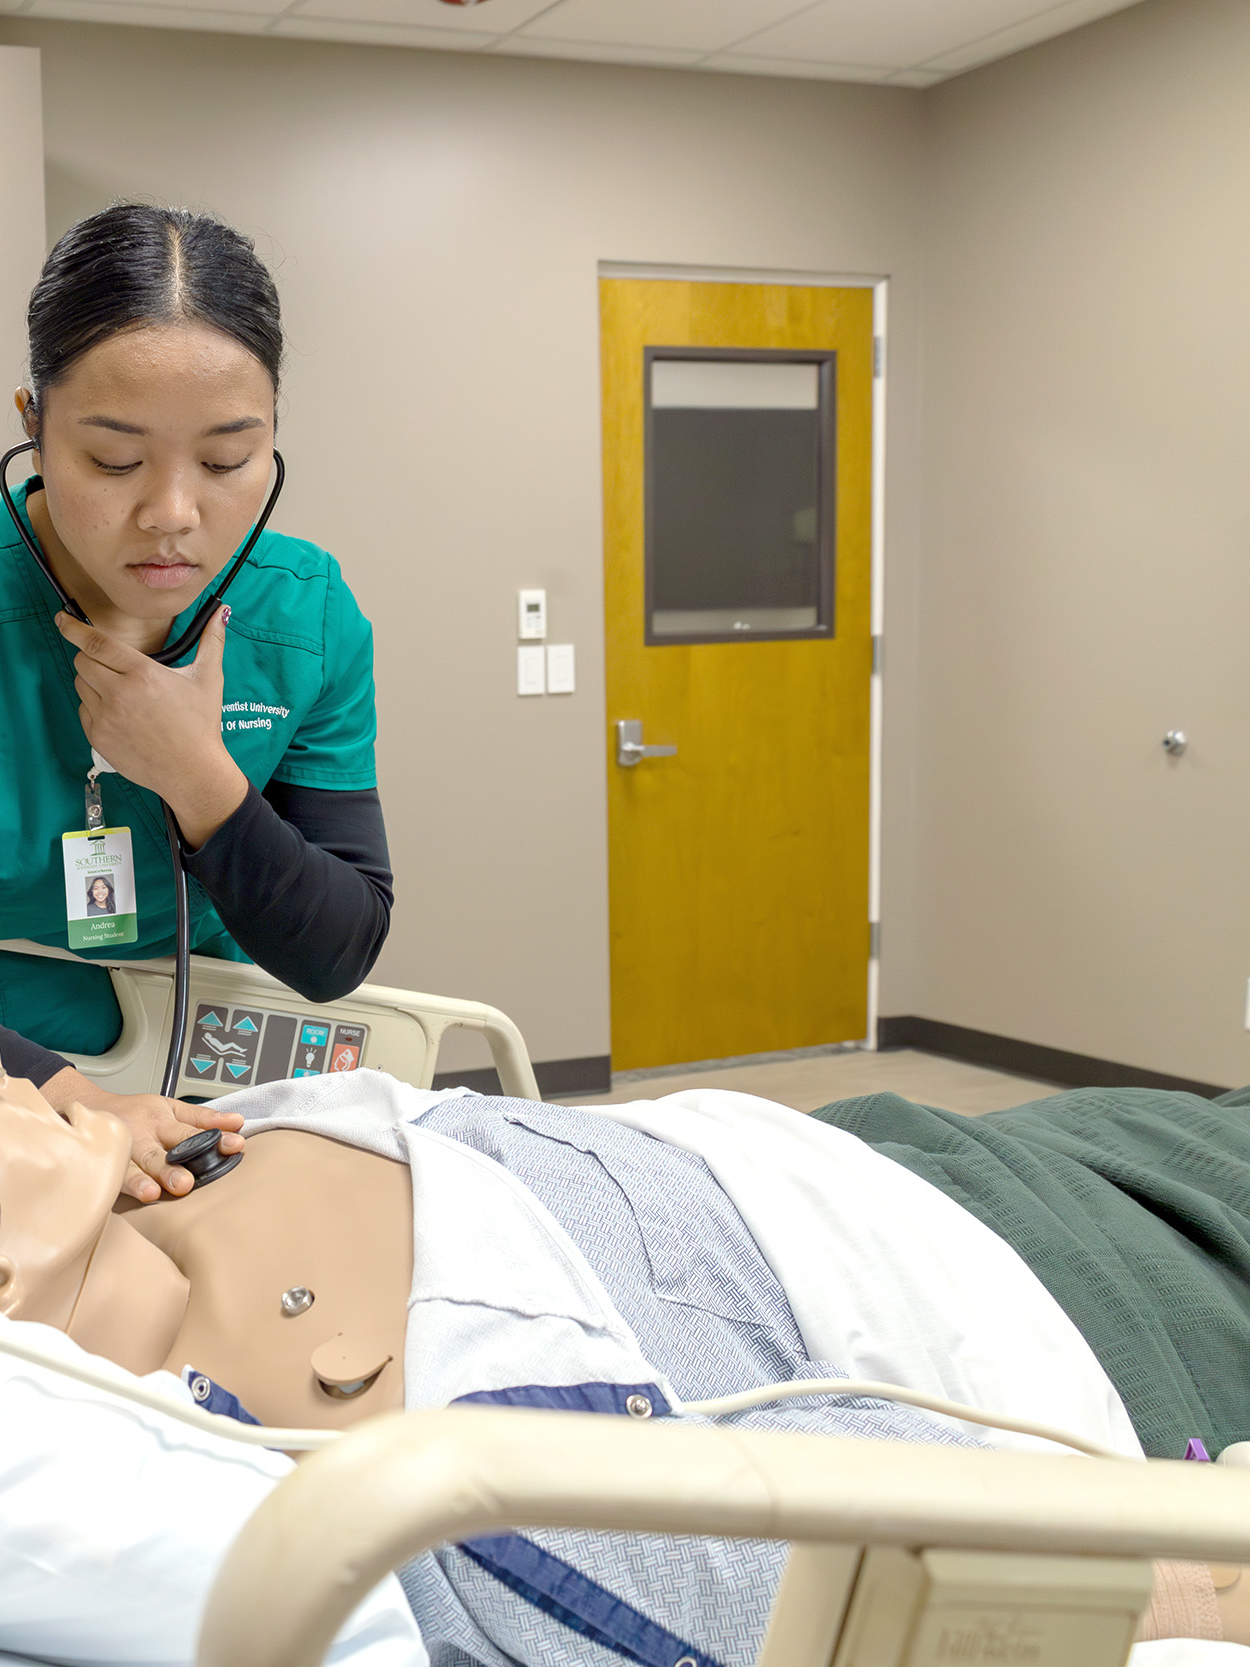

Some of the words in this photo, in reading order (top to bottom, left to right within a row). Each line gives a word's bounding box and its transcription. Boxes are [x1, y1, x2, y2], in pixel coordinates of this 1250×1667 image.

[222, 701, 248, 713] ventist
[250, 702, 290, 719] University
[226, 720, 237, 731] Of
[238, 717, 272, 730] Nursing
[75, 854, 122, 867] SOUTHERN
[90, 921, 116, 930] Andrea
[104, 931, 125, 939] Student
[339, 1028, 361, 1037] NURSE
